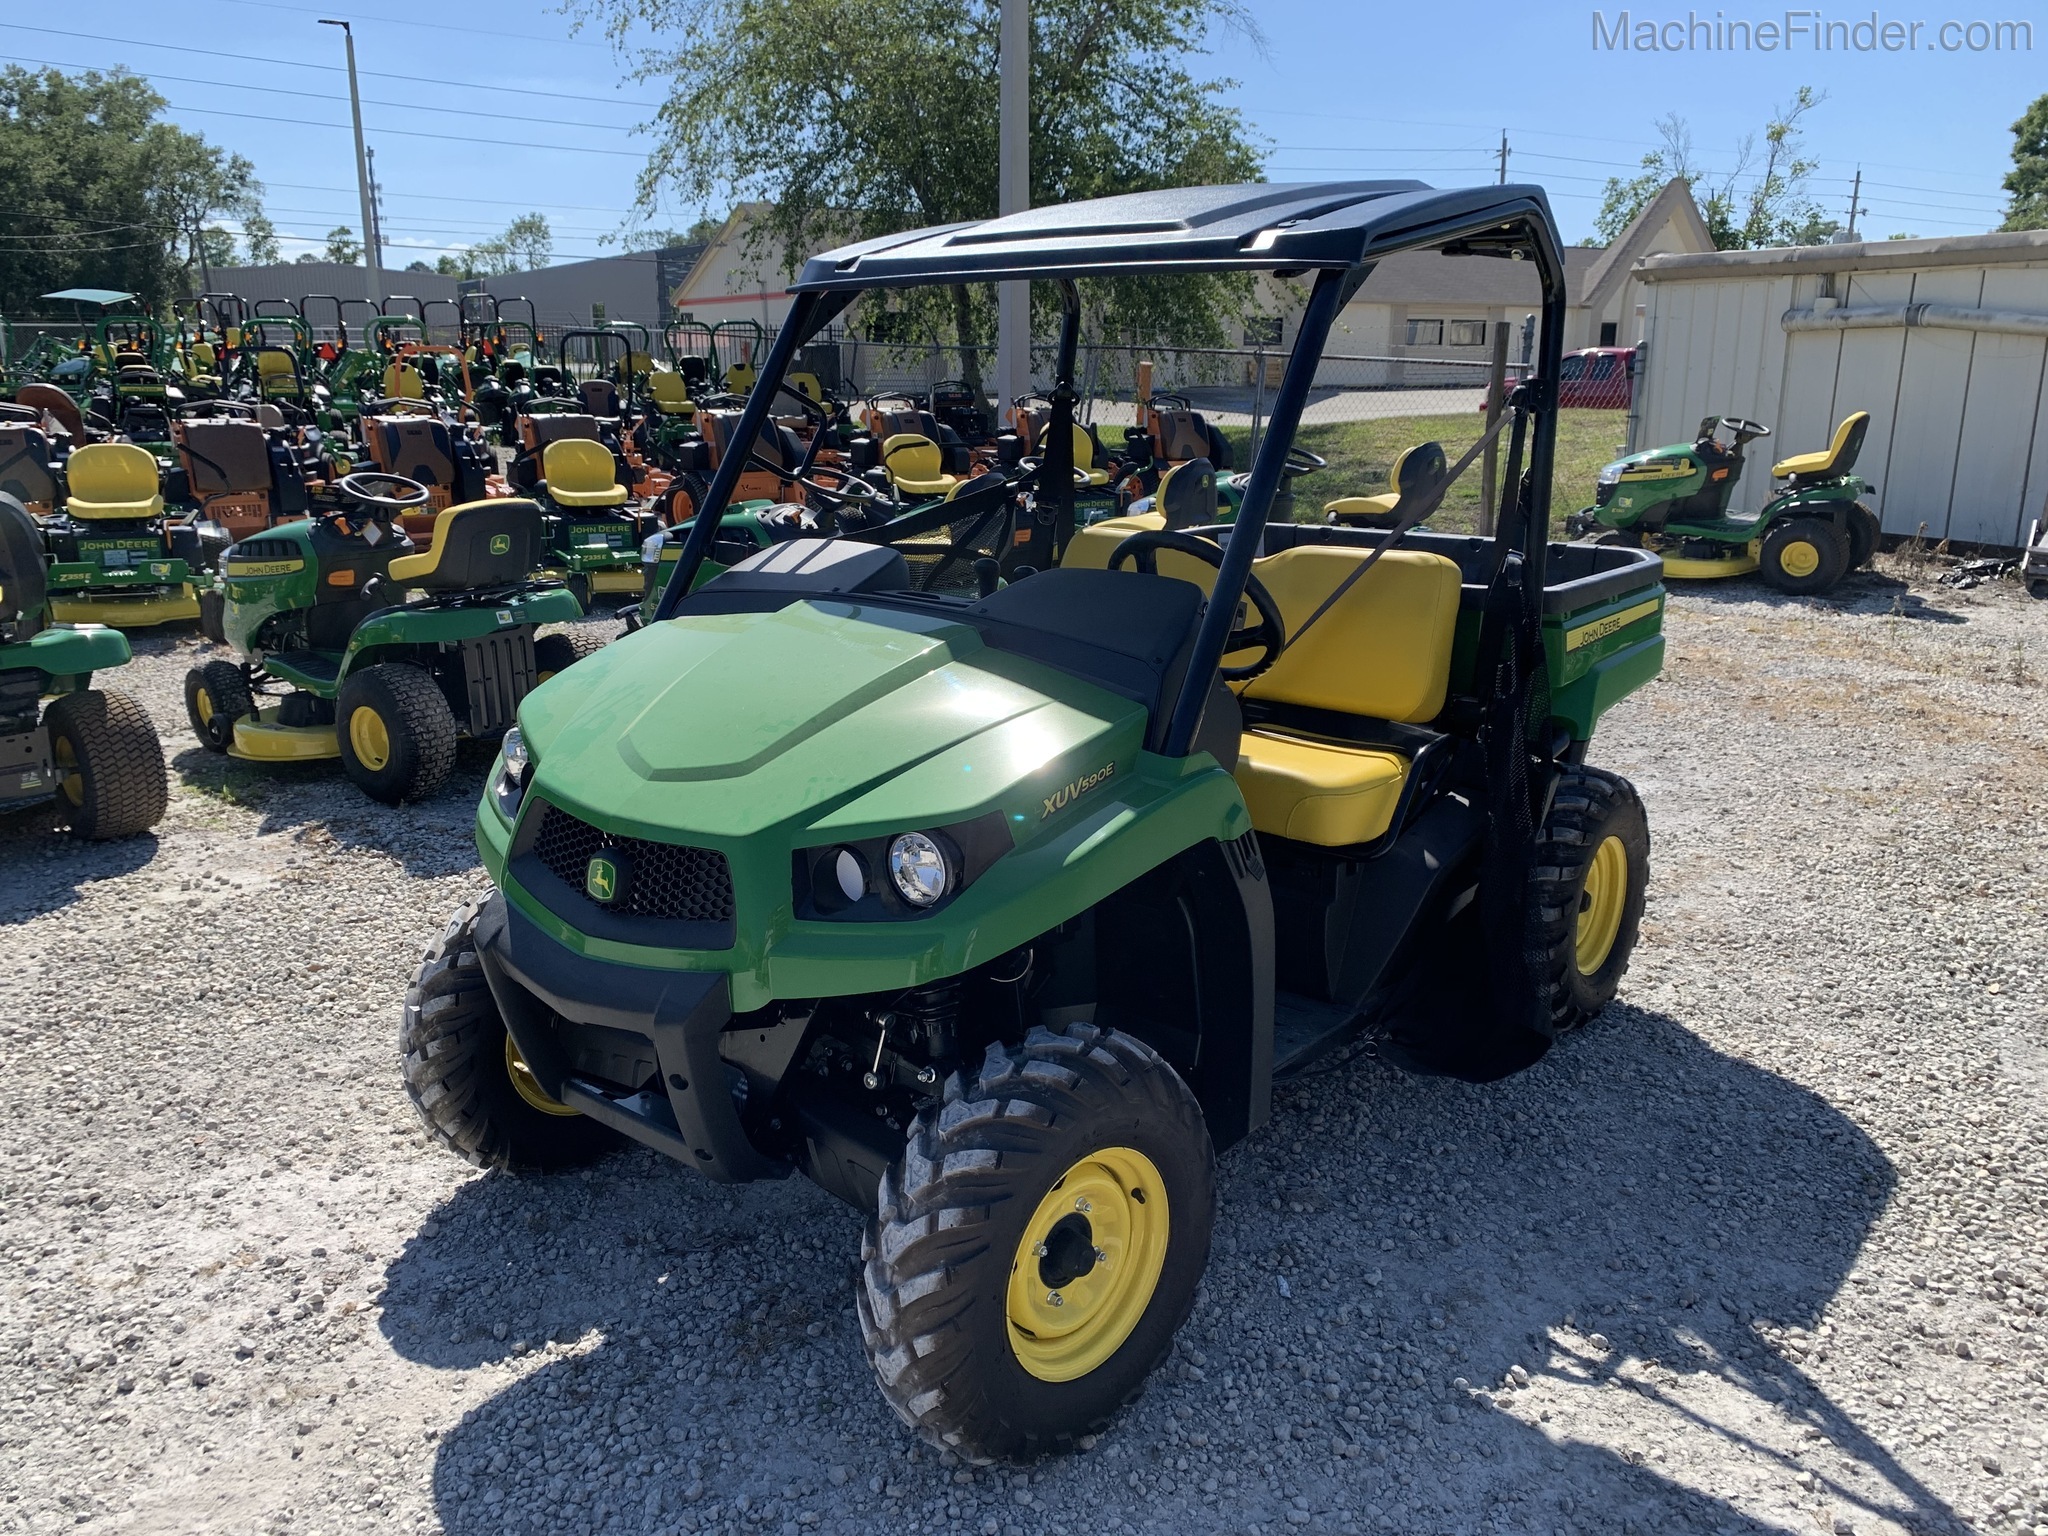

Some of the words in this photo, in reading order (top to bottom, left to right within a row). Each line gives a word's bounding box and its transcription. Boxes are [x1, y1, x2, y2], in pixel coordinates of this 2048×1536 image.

[571, 526, 597, 534] JOHN
[598, 525, 630, 533] DEERE
[80, 541, 114, 551] JOHN
[116, 540, 158, 549] DEERE
[245, 565, 264, 575] JOHN
[264, 564, 292, 573] DEERE
[1580, 628, 1599, 646] JOHN
[1599, 618, 1621, 637] DEERE
[1041, 762, 1115, 819] XUV590E
